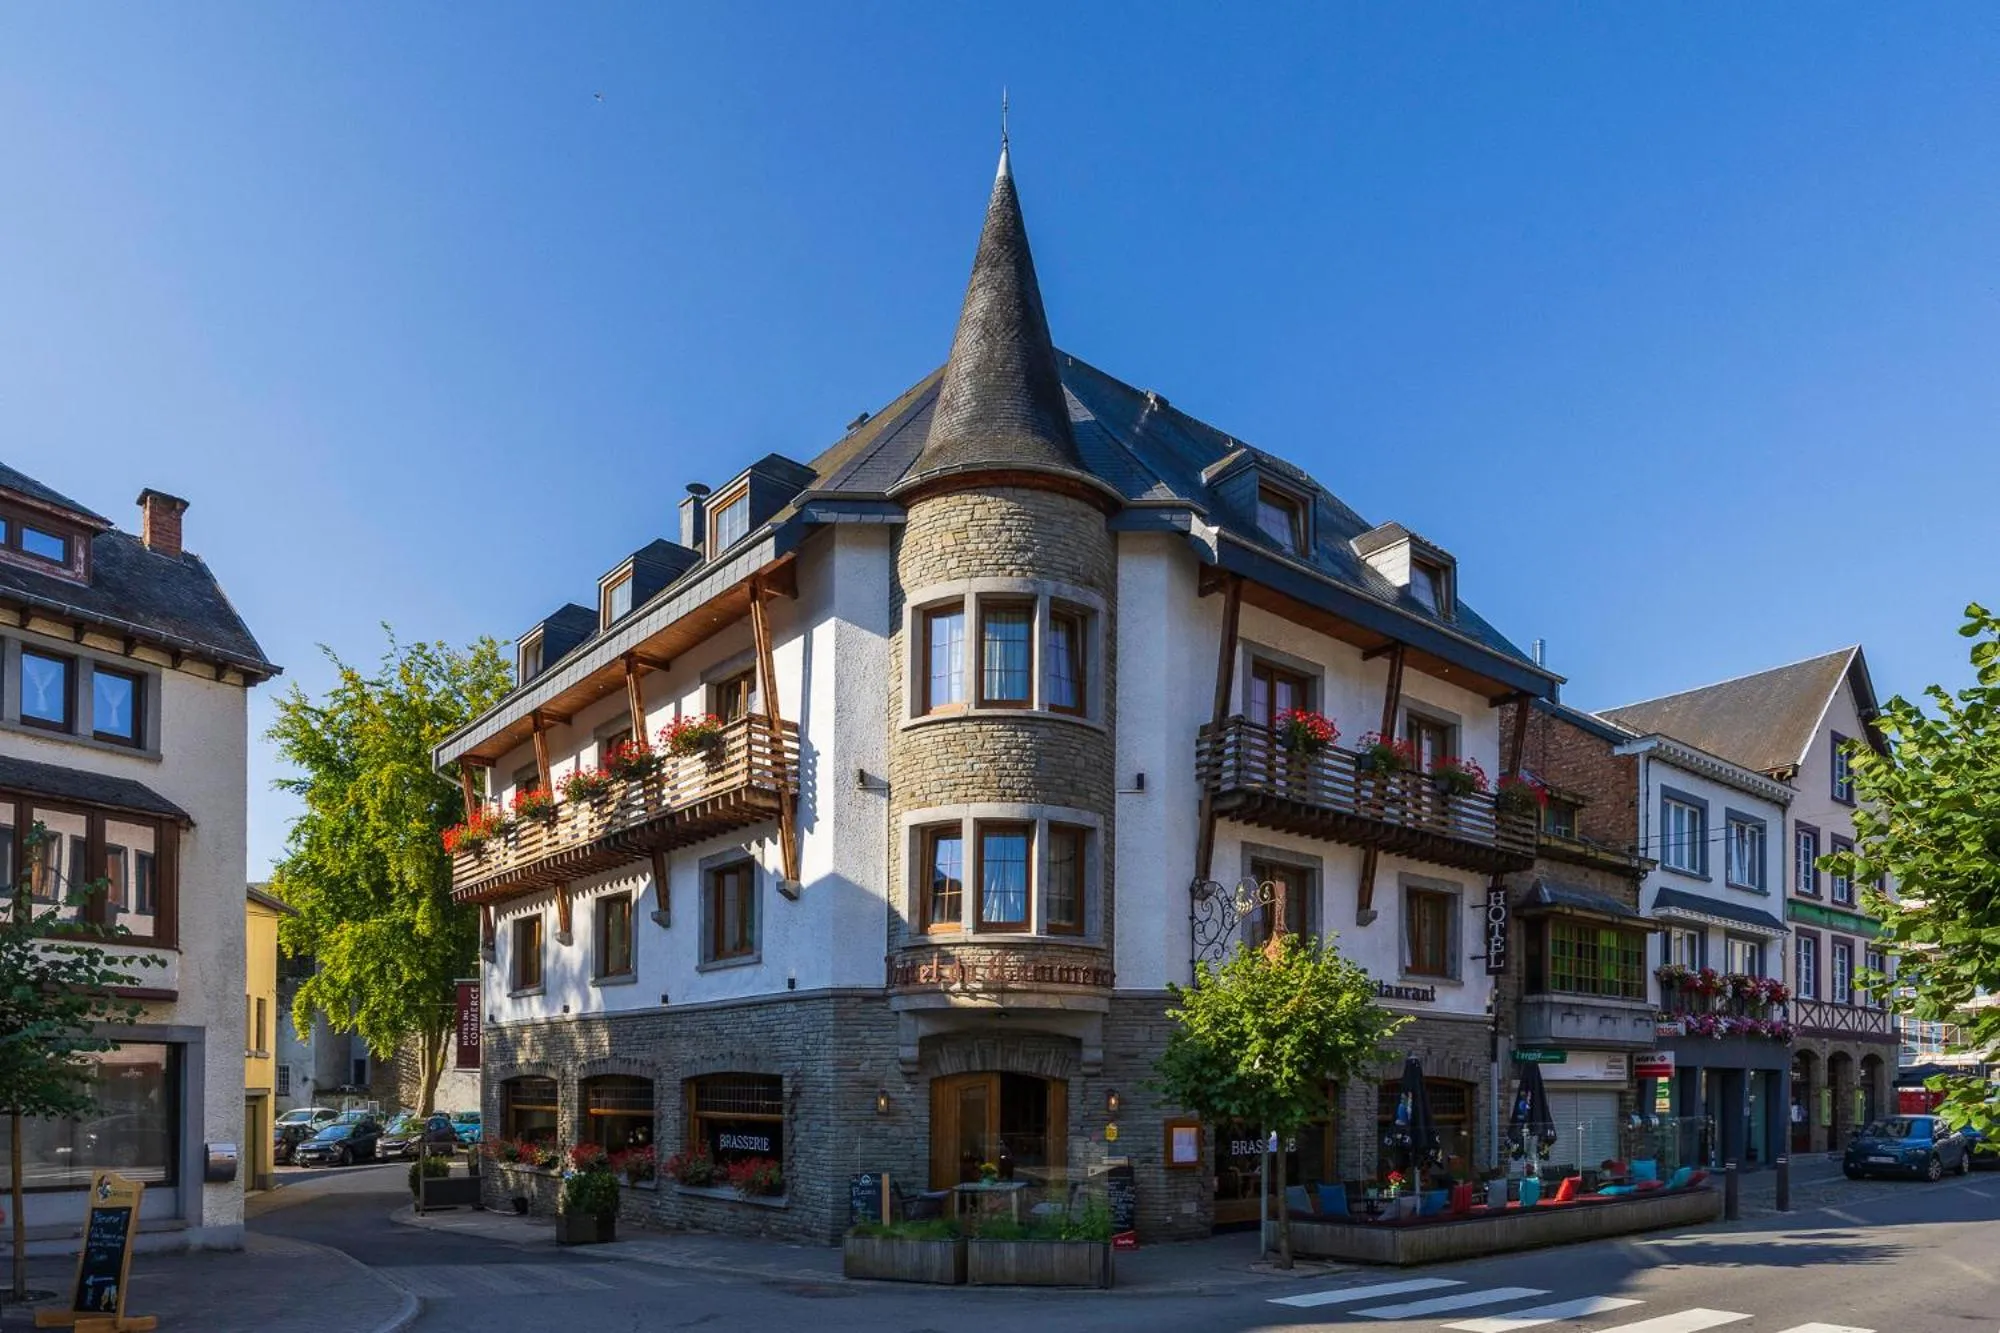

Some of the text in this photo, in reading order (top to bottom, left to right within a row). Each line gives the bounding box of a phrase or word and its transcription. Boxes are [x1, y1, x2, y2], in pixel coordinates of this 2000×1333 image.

[1488, 891, 1505, 968] HOTEL
[1376, 979, 1436, 1002] taurant
[470, 987, 480, 1046] COMMERCE
[720, 1134, 769, 1151] BRASSERIE
[1231, 1137, 1297, 1155] BRASIE
